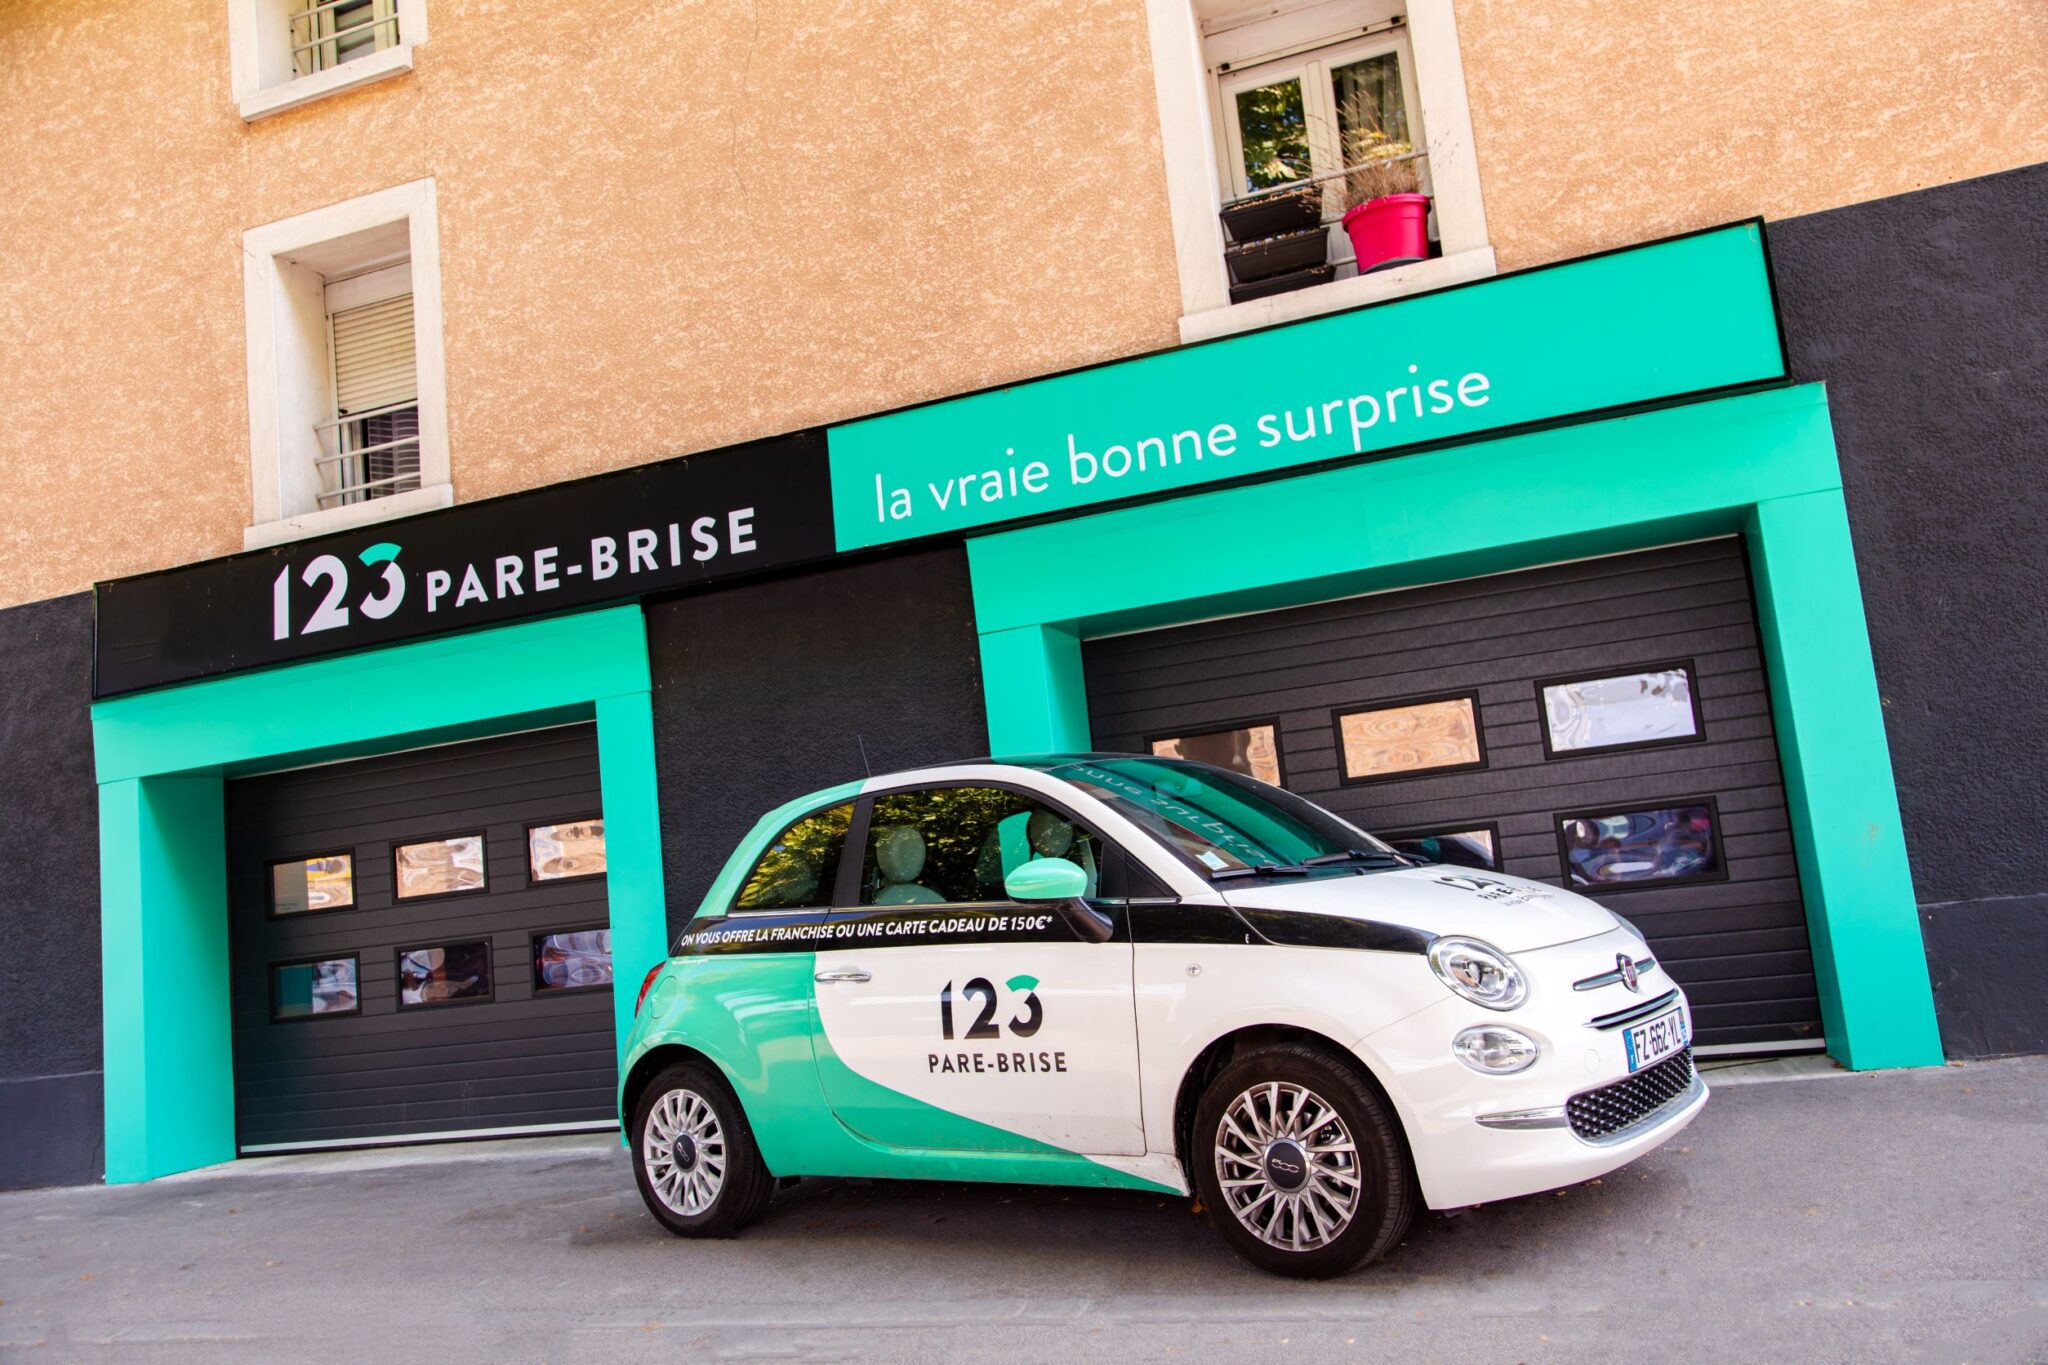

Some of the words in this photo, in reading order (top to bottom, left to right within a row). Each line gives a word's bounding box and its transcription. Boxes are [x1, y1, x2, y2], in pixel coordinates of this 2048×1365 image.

[874, 473, 913, 523] la
[927, 447, 1050, 508] vraie
[1067, 433, 1238, 486] bonne
[1256, 363, 1492, 452] surprise
[273, 541, 406, 641] 123
[426, 506, 758, 613] PARE-BRISE
[681, 933, 696, 947] ON
[695, 930, 721, 945] VOUS
[721, 929, 754, 943] OFFRE
[755, 928, 769, 942] LA
[770, 925, 835, 941] FRANCHISE
[835, 924, 854, 939] OU
[857, 922, 883, 937] UNE
[885, 920, 926, 936] CARTE
[928, 918, 984, 933] CADEAU
[987, 916, 1009, 932] DE
[940, 974, 1044, 1041] 123
[928, 1052, 1068, 1073] PARE-BRISE
